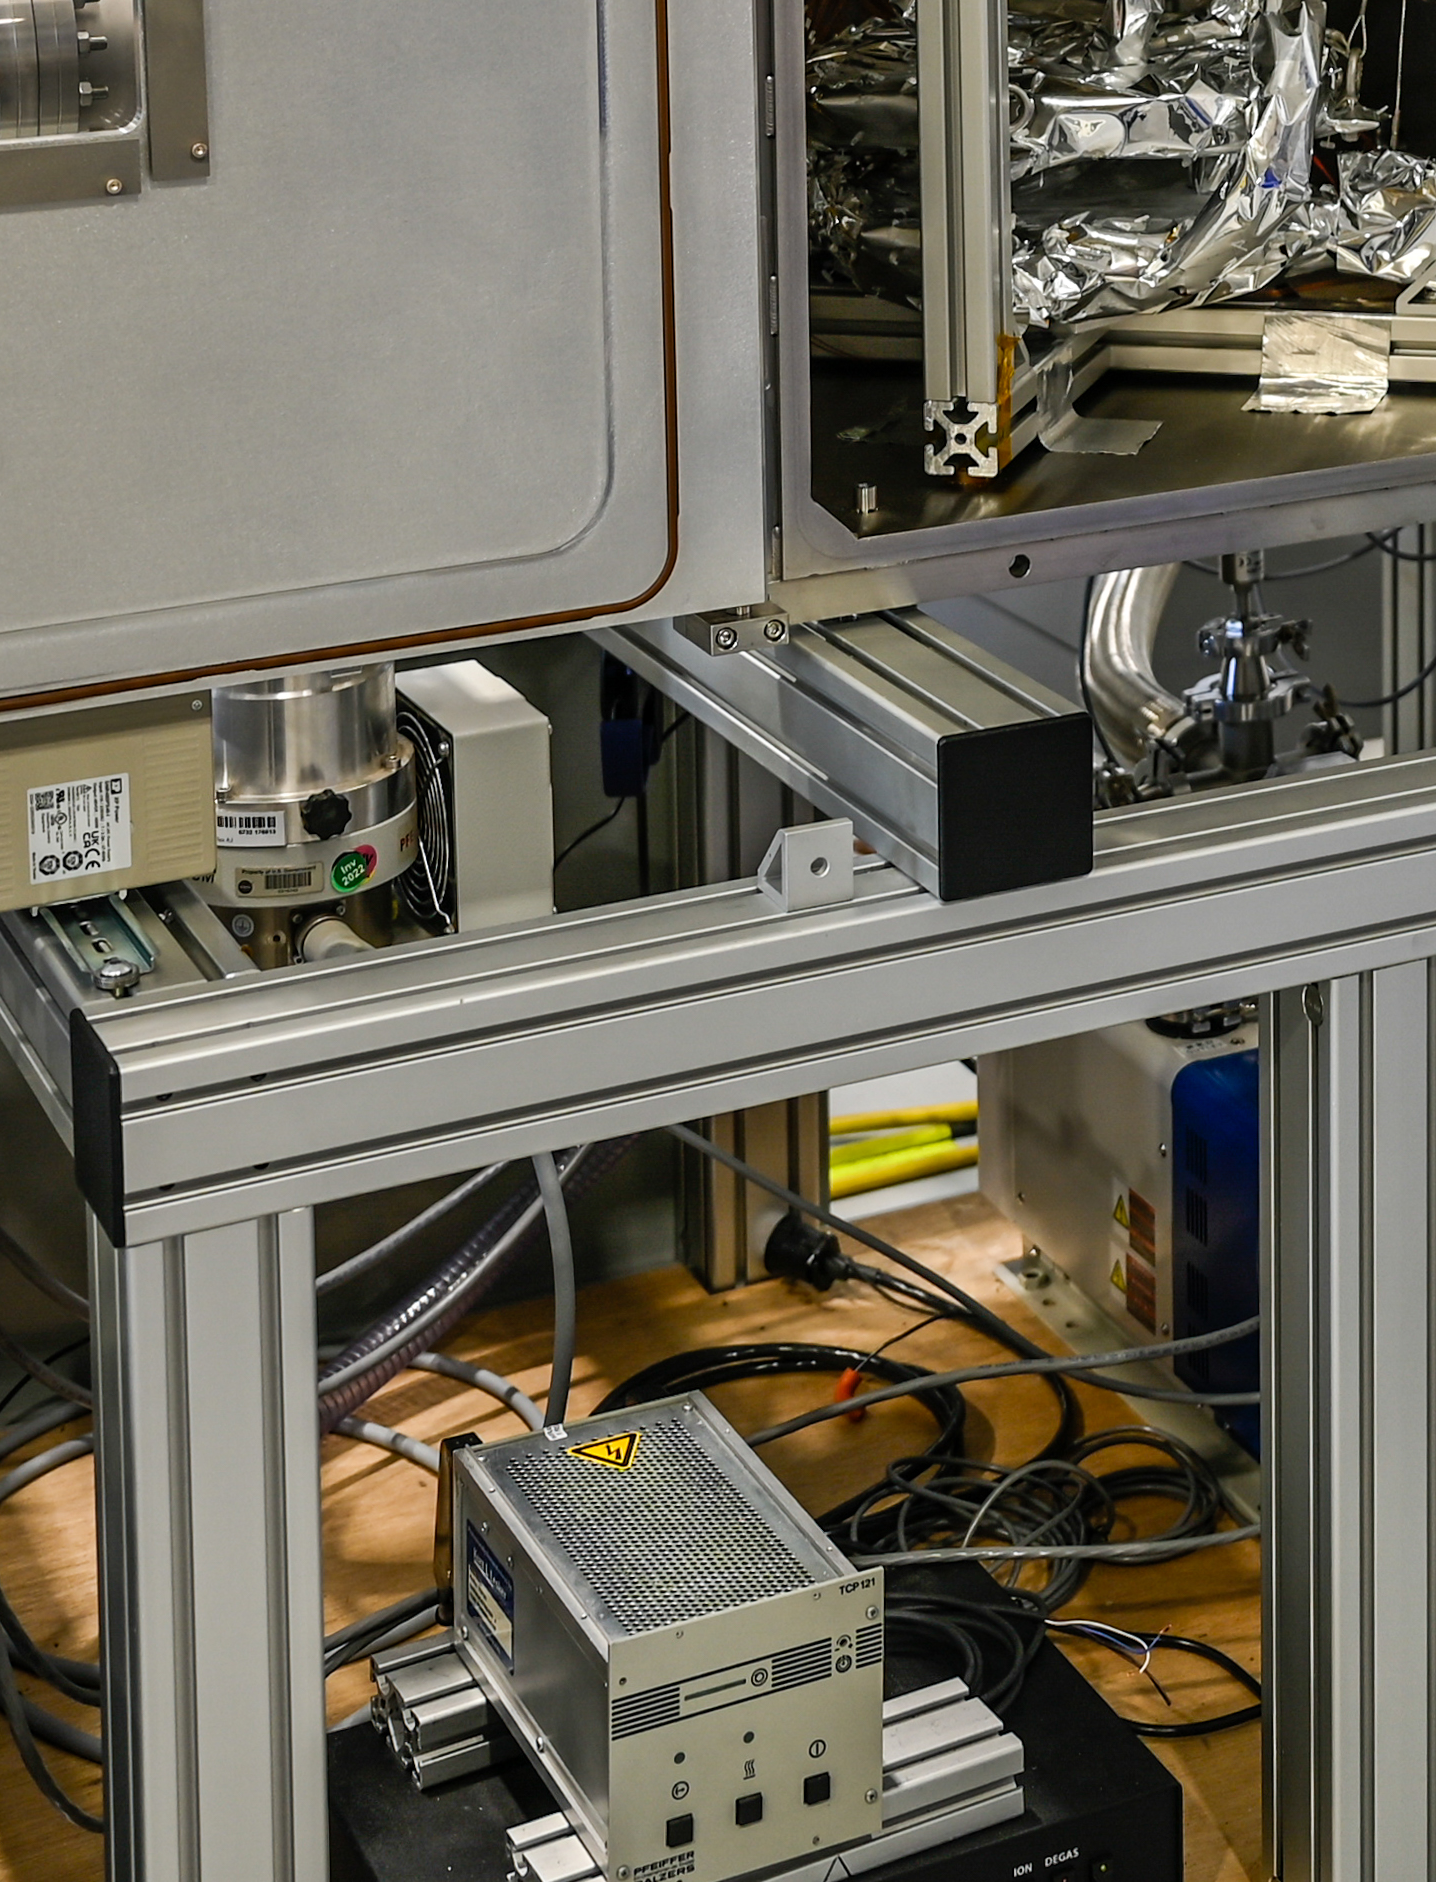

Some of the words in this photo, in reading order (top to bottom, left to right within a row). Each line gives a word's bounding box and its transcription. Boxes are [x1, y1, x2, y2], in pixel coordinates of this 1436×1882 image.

[341, 859, 357, 874] Inv
[342, 864, 365, 886] 2022
[839, 1581, 859, 1595] TCP
[861, 1577, 875, 1589] 121
[633, 1850, 695, 1876] PFEIFFER
[1013, 1862, 1033, 1877] ION
[1044, 1847, 1080, 1868] DEGAS
